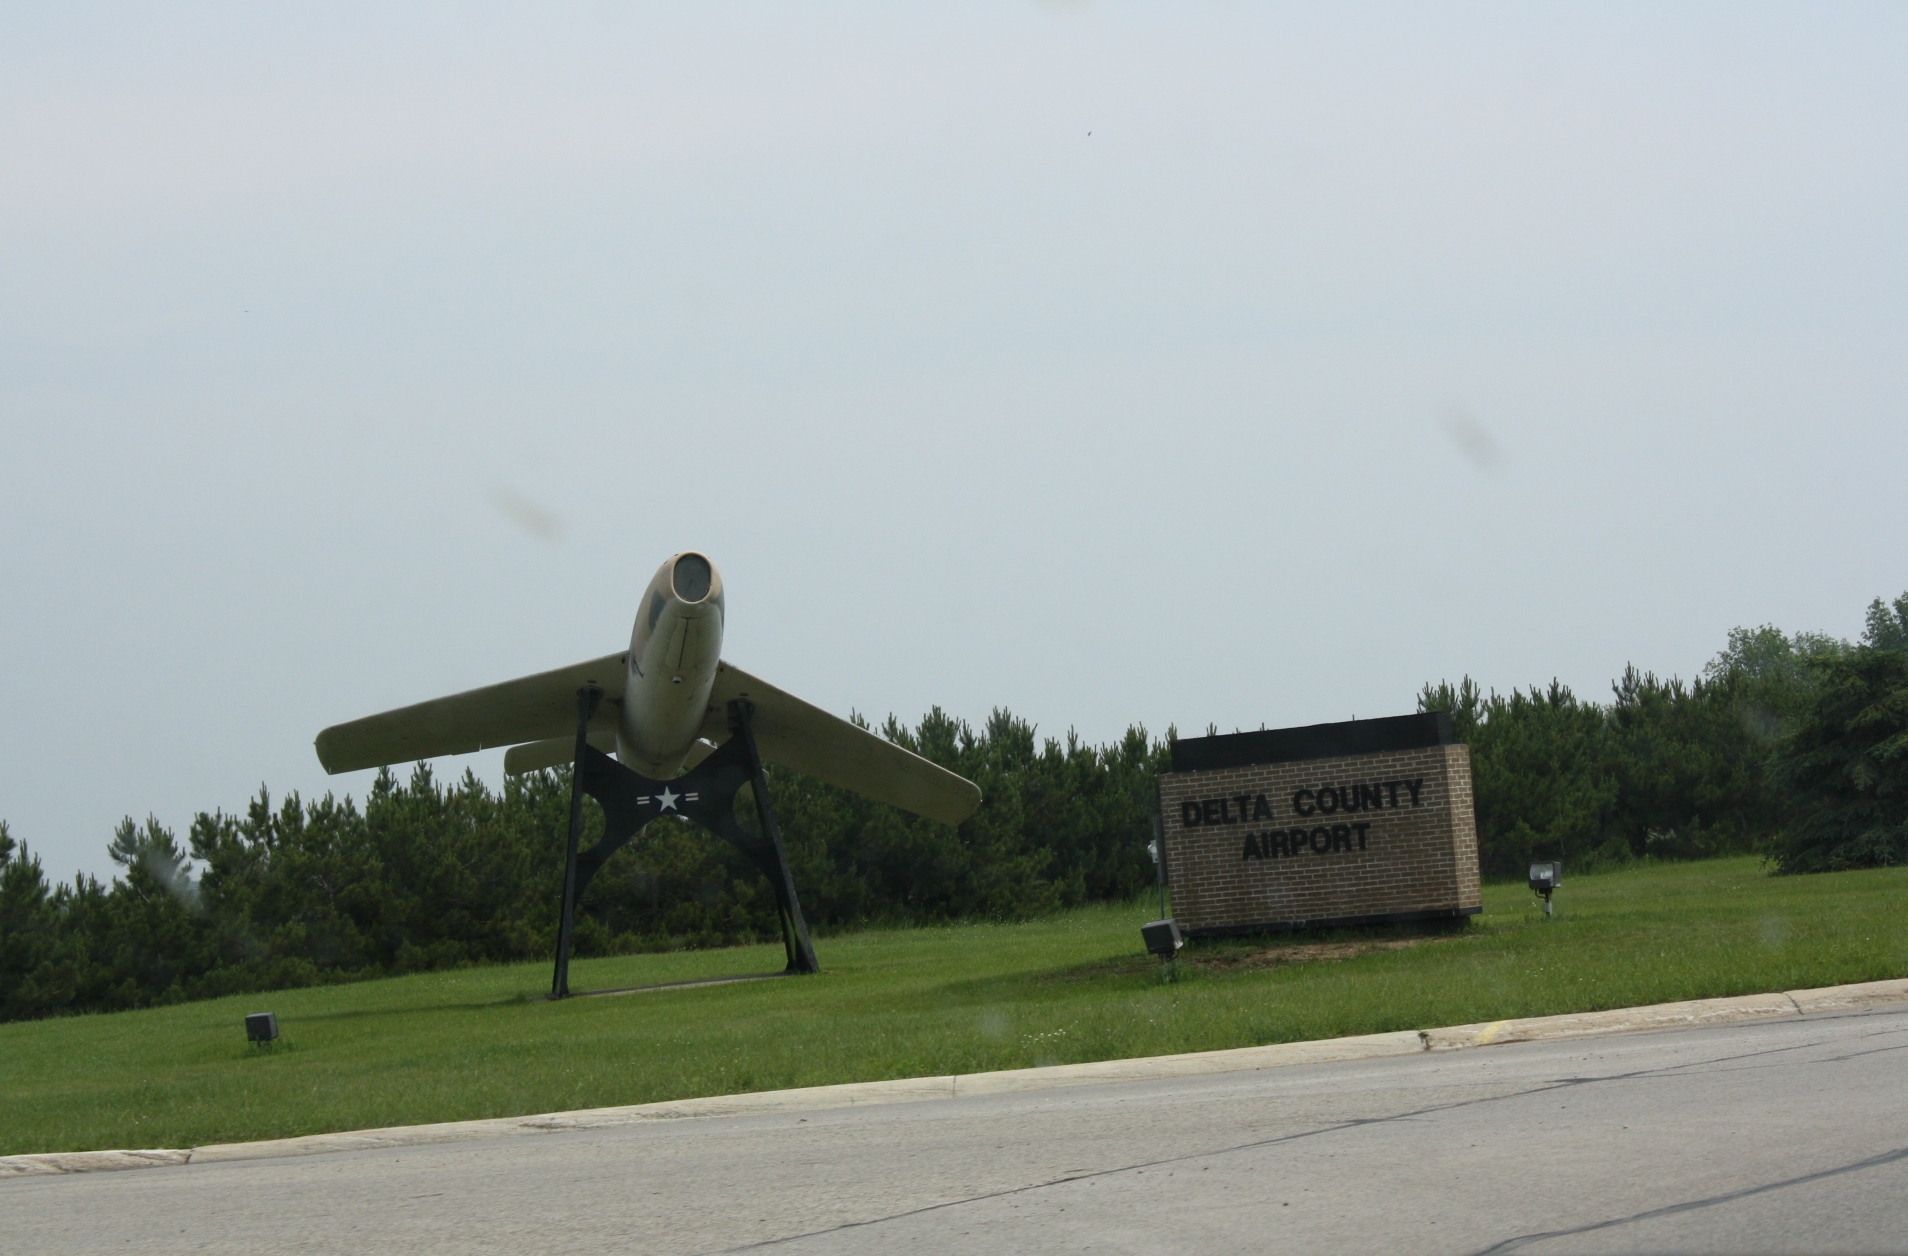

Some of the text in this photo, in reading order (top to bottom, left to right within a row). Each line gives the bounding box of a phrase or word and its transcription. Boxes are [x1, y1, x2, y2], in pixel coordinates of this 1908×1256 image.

[1181, 778, 1423, 828] DELTA COUNTY
[1242, 822, 1371, 861] AIRPORT
